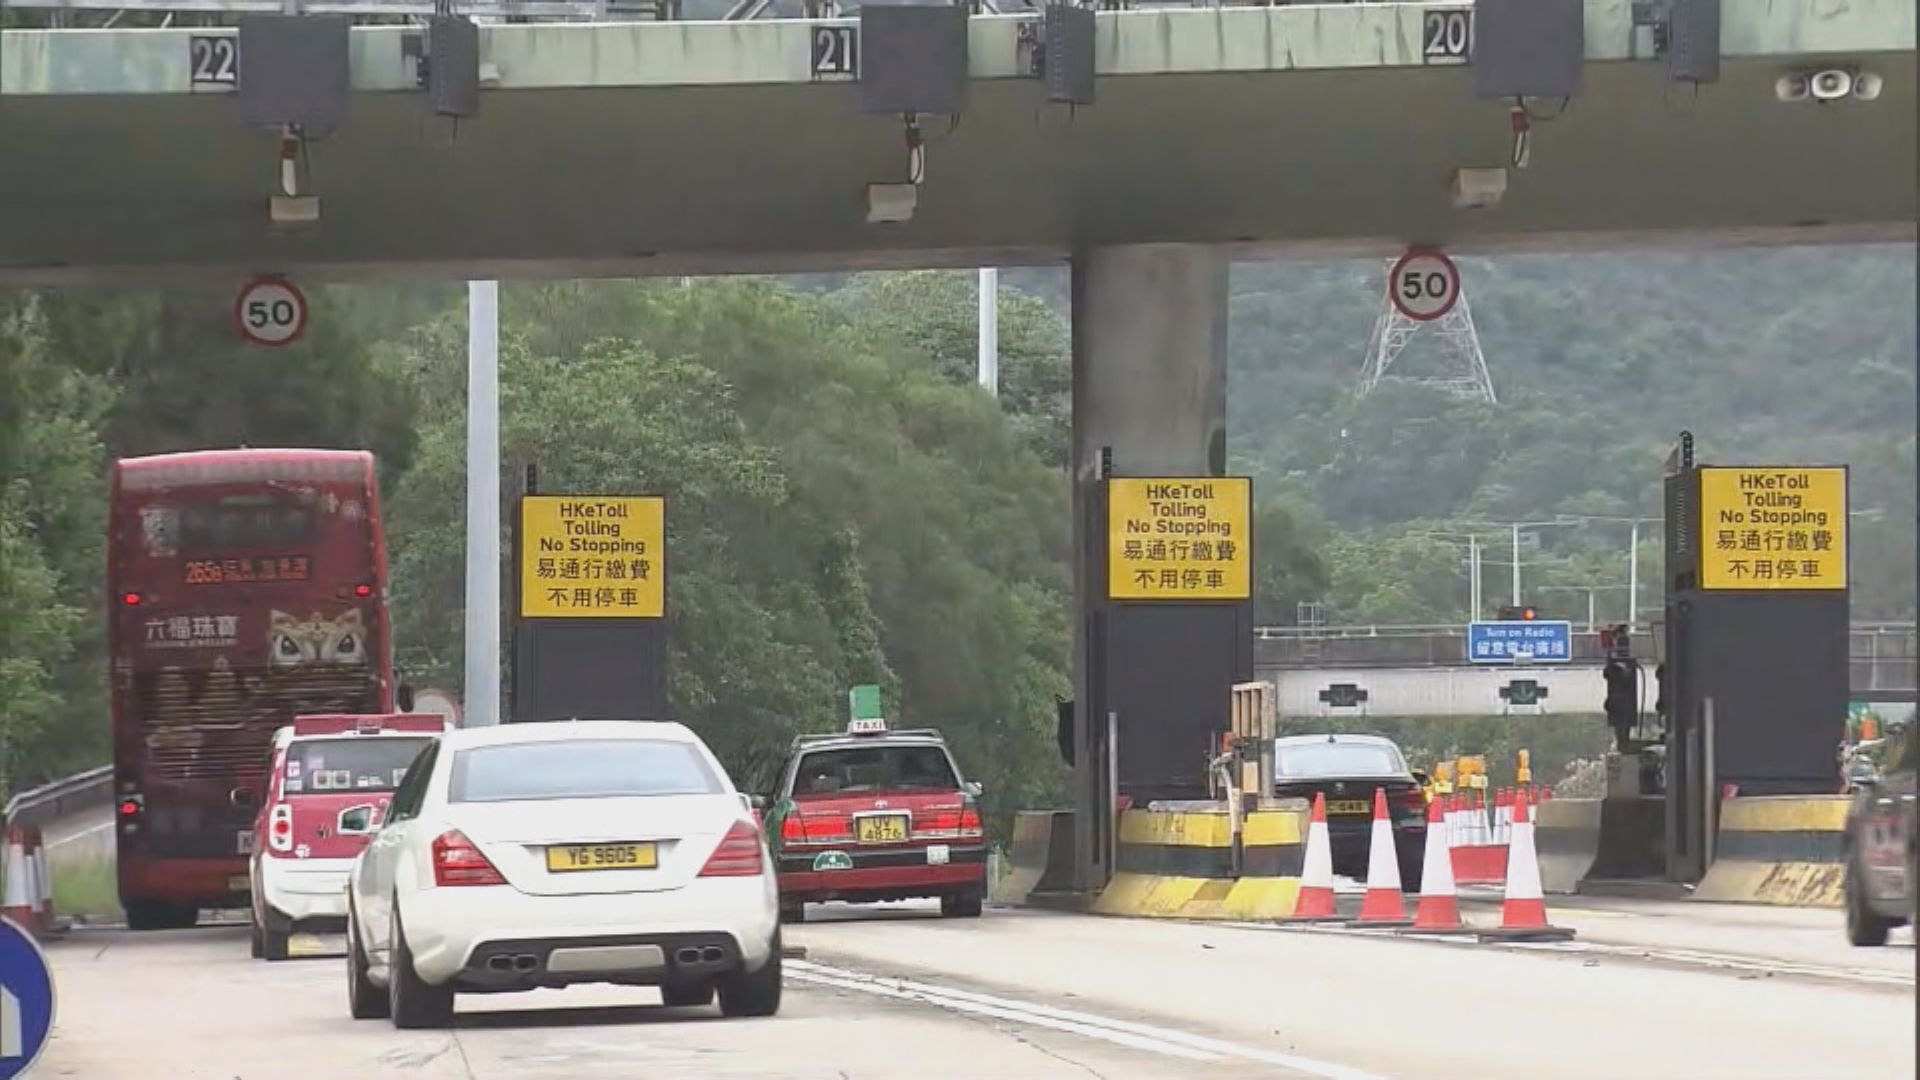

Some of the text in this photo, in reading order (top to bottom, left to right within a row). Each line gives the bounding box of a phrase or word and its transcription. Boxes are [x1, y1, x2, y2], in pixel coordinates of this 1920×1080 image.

[1425, 12, 1466, 54] 20
[193, 38, 234, 80] 22
[816, 30, 851, 70] 21
[1403, 272, 1447, 299] 50
[249, 300, 294, 328] 50
[1739, 474, 1809, 489] HKeToll
[1146, 484, 1214, 499] HKeToll
[1743, 492, 1802, 508] Tolling
[560, 503, 628, 517] HKeToll
[1150, 502, 1206, 519] Tolling
[1720, 509, 1827, 526] No Stopping
[565, 520, 620, 537] Tolling
[1127, 519, 1231, 536] No Stopping
[541, 538, 645, 555] No Stopping
[1716, 530, 1832, 551] 易通行繳費
[1123, 540, 1236, 561] 易通行繳費
[537, 558, 650, 580] 易通行繳費
[1728, 559, 1822, 579] 不用停車
[1134, 569, 1224, 589] 不用停車
[547, 588, 639, 607] 不用停車
[1524, 627, 1555, 637] Radio
[856, 721, 883, 730] TAXI
[568, 846, 637, 865] YG 9605
